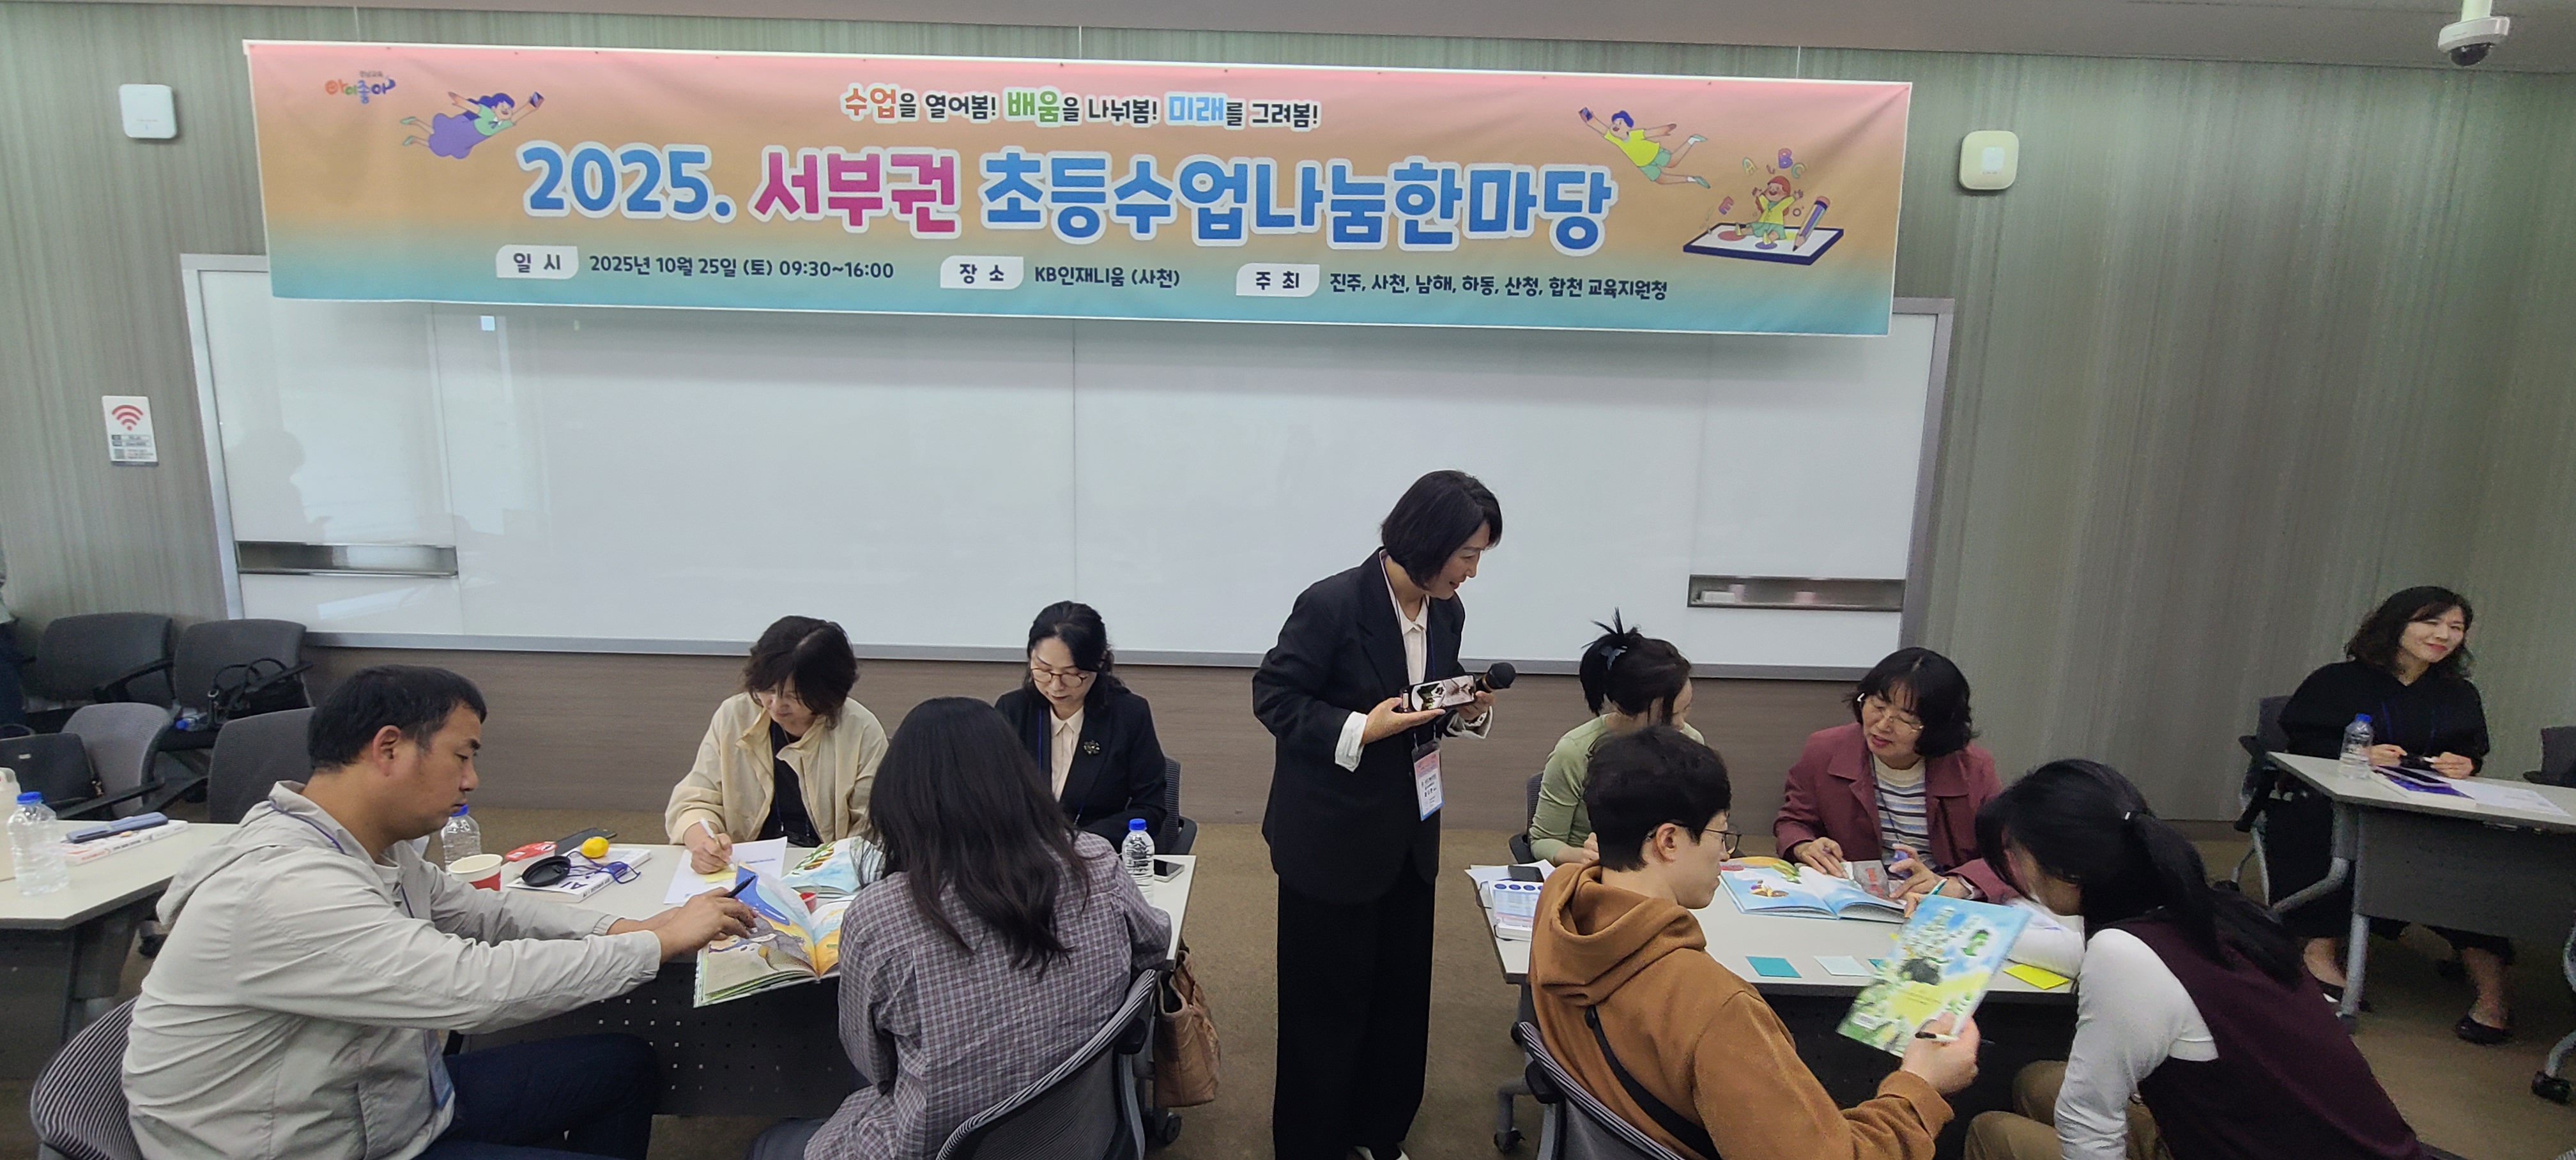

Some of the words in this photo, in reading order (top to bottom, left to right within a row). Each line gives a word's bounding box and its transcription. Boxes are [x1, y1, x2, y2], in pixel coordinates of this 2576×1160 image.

[845, 88, 916, 118] 수업을
[925, 94, 996, 119] 열어봄!
[1007, 91, 1080, 122] 배움을
[1088, 98, 1157, 124] 나눠봄!
[1169, 96, 1243, 126] 미래를
[1252, 103, 1317, 128] 그려봄!
[521, 146, 731, 217] 2025.
[753, 151, 956, 233] 서부권
[983, 152, 1612, 250] 초등수업나눔한마당
[513, 252, 532, 273] 일
[543, 254, 561, 271] 시
[589, 255, 650, 275] 2025년
[656, 256, 693, 277] 10월
[698, 258, 737, 278] 25일
[743, 259, 773, 276] (토)
[779, 260, 894, 279] 09:30~16:00
[959, 263, 977, 284] 장
[989, 264, 1004, 282] 소
[1034, 266, 1124, 287] KB인재니움
[1131, 268, 1180, 289] (사천)
[1255, 271, 1271, 290] 주
[1282, 271, 1300, 289] 최
[1330, 273, 1367, 293] 진주,
[1371, 273, 1410, 294] 사천,
[1414, 274, 1457, 294] 남해,
[1462, 275, 1499, 296] 하동,
[1504, 276, 1544, 297] 산청,
[1548, 276, 1583, 298] 합천
[1588, 279, 1667, 301] 교육지원청
